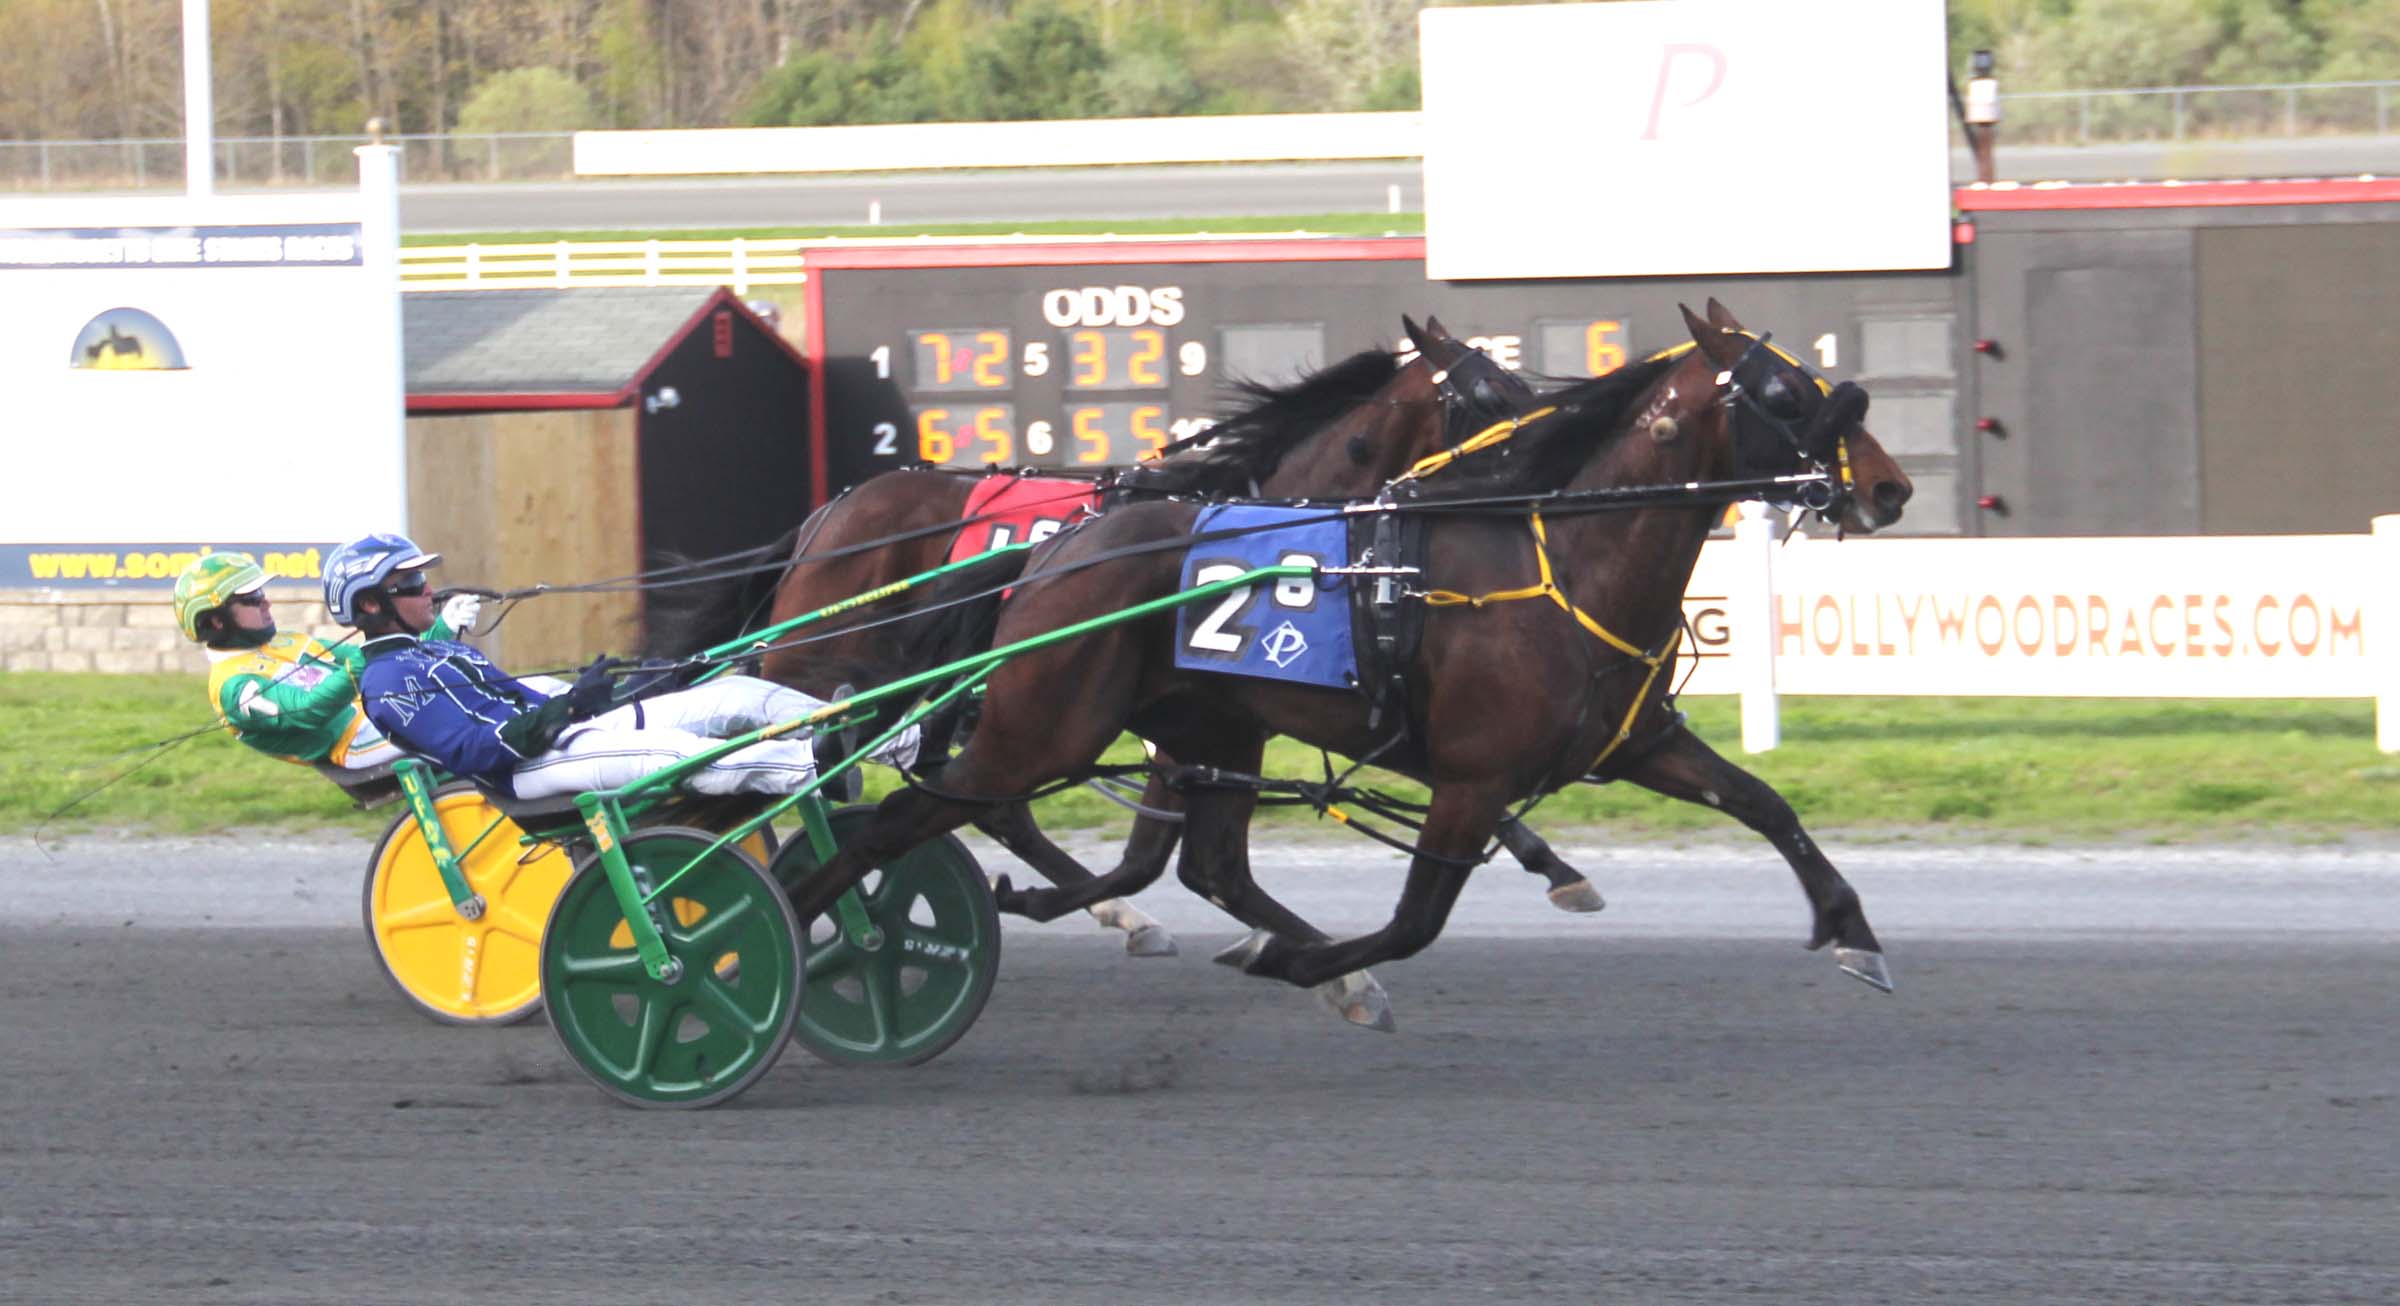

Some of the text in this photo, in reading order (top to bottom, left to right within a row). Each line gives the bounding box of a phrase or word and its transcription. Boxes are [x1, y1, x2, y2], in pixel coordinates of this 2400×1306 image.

[1043, 285, 1185, 328] ODDS
[870, 345, 890, 378] 1
[1023, 342, 1050, 376] 5
[1178, 341, 1206, 376] 9
[1813, 333, 1838, 369] 1
[872, 422, 897, 455] 2
[1026, 420, 1055, 455] 6
[1772, 592, 2366, 659] HOLLYWOODRACES.COM
[380, 675, 436, 727] M
